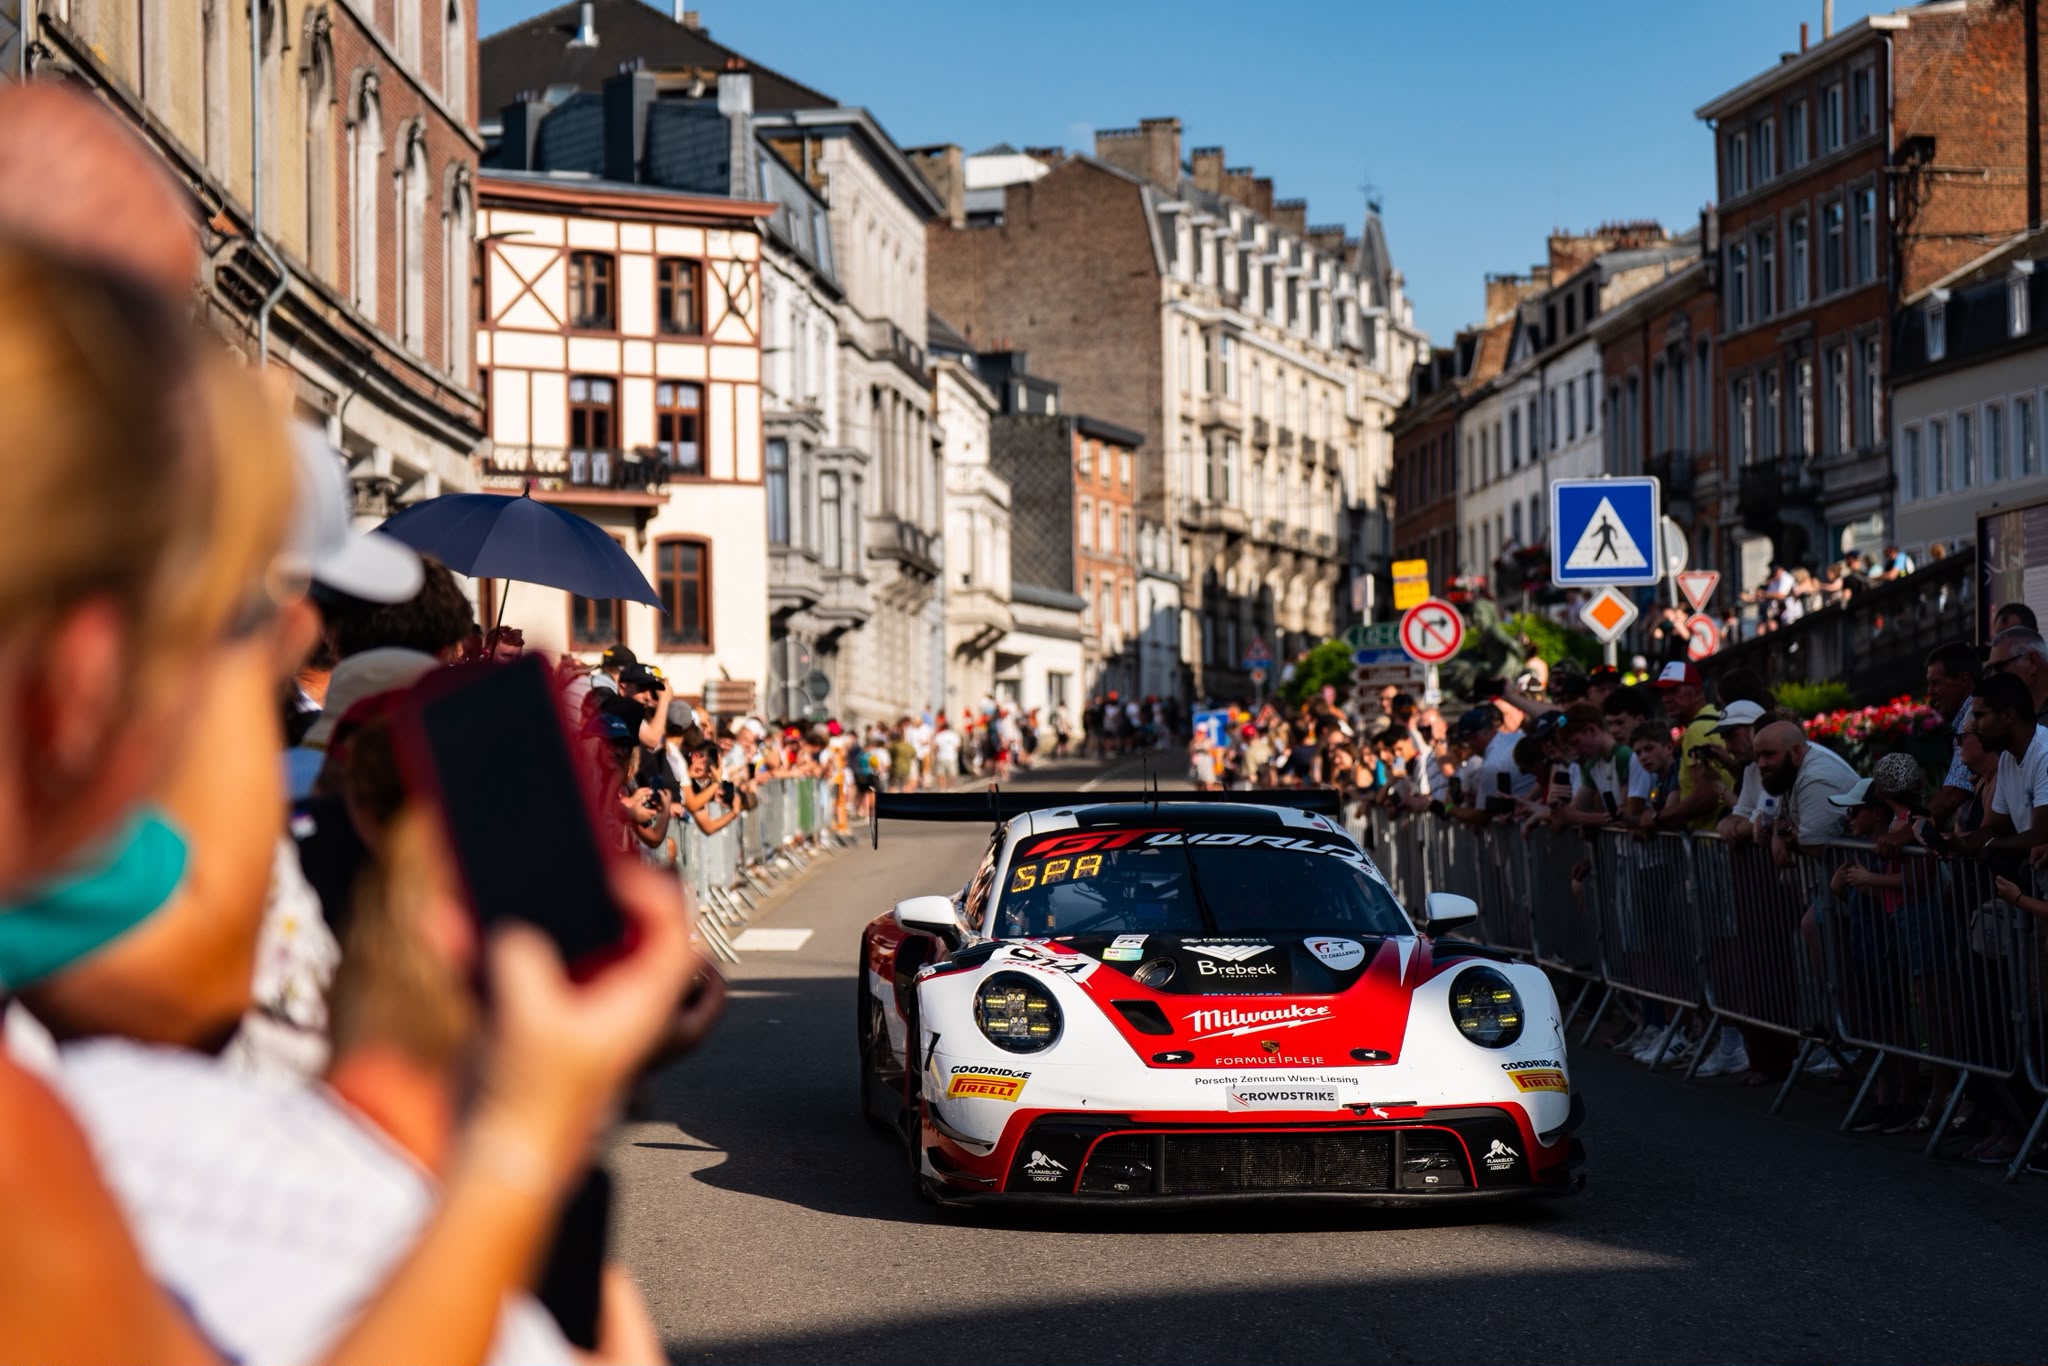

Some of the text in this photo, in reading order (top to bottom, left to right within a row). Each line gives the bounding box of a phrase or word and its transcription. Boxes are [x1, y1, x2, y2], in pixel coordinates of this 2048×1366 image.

[1024, 828, 1366, 863] GT WORLD
[1011, 854, 1103, 894] SPA
[1329, 950, 1360, 959] CHALLENGE
[1197, 960, 1277, 975] Brebeck
[1182, 1004, 1332, 1033] Milwaukee
[951, 1065, 1033, 1079] GOODRIDGE
[1501, 1059, 1563, 1071] GOODRIDGE
[952, 1077, 1018, 1097] PIRELLI
[1195, 1075, 1359, 1085] Porsche Zentrum Wien-Liesing
[1240, 1091, 1335, 1102] CROWDSTRIKE
